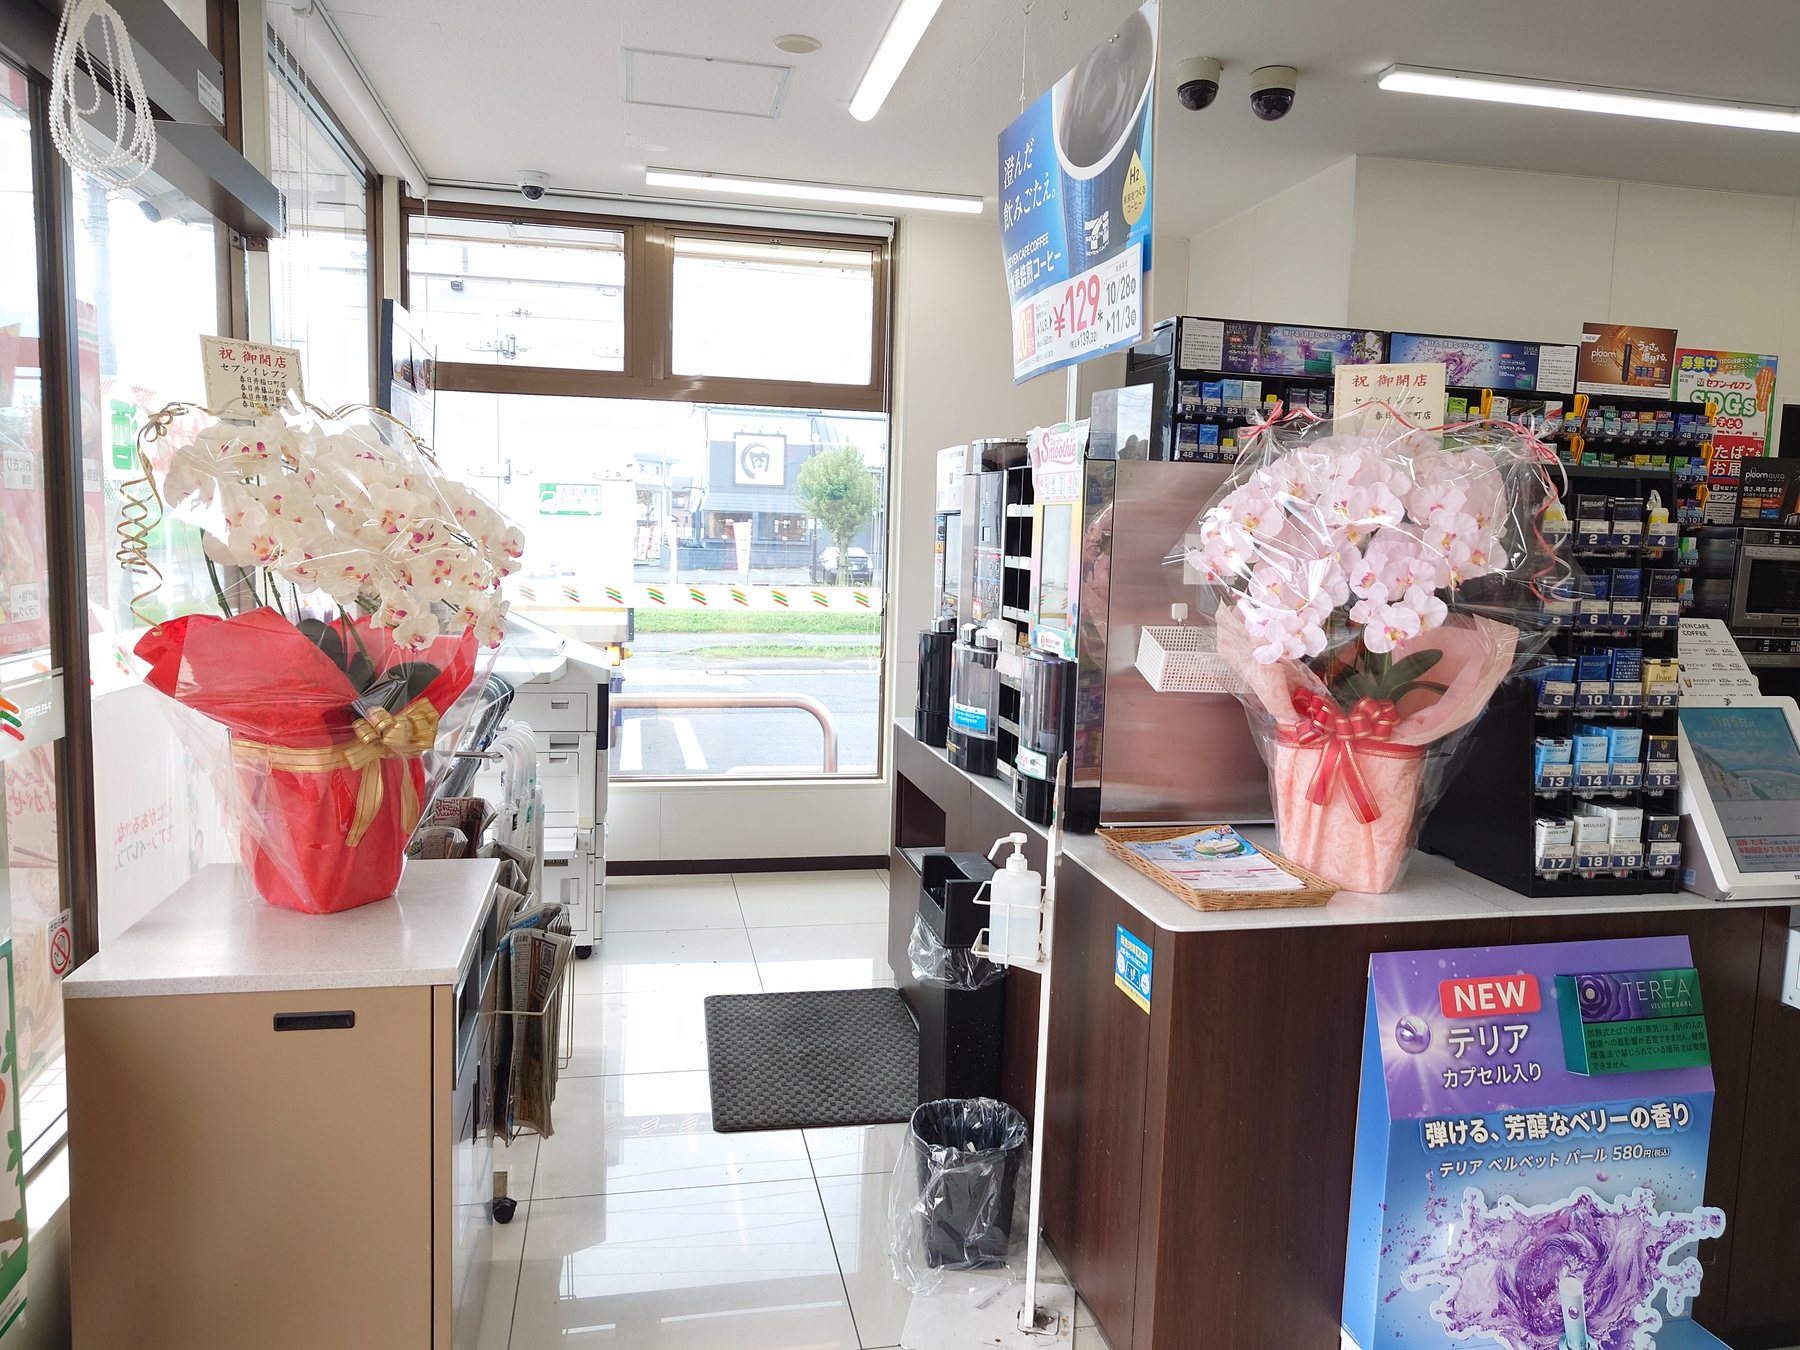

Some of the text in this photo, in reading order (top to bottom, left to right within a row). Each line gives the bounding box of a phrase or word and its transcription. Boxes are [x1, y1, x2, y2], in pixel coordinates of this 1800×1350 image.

[1004, 138, 1035, 189] 澄んだ
[1004, 172, 1056, 232] 飲みごたえ。
[218, 347, 287, 369] 祝 御開店
[1680, 355, 1718, 372] 募集中
[220, 363, 288, 379] セブンイレブン
[1352, 374, 1428, 388] 祝 御開店
[1185, 404, 1196, 412] 21
[1690, 390, 1757, 417] SDGs
[1041, 432, 1077, 463] Smoothie
[1202, 452, 1214, 460] 49
[1588, 534, 1598, 544] 2
[1621, 534, 1631, 545] 3
[1656, 536, 1666, 546] 4
[1589, 614, 1598, 625] 6
[1623, 614, 1632, 625] 7
[1658, 616, 1668, 626] 8
[1552, 695, 1563, 705] 9
[1587, 695, 1603, 705] 10
[1620, 695, 1634, 705] 11
[1656, 695, 1671, 705] 12
[1656, 751, 1670, 759] Peace
[1549, 777, 1565, 787] 13
[1586, 776, 1602, 786] 14
[1619, 775, 1634, 785] 15
[1656, 775, 1671, 785] 16
[1550, 858, 1567, 869] 17
[1587, 856, 1603, 866] 18
[1620, 856, 1635, 866] 19
[1655, 856, 1672, 865] 20
[1622, 979, 1691, 1001] TEREA
[1453, 980, 1527, 1012] NEW
[1671, 1000, 1692, 1008] PEARL
[1447, 1022, 1530, 1059] テリア
[1442, 1063, 1543, 1090] カプセル入り
[1425, 1102, 1690, 1149] 弾ける、芳醇なベリーの香り
[1440, 1157, 1483, 1178] テリア
[1488, 1152, 1560, 1171] ベルベット
[1566, 1147, 1608, 1164] パール
